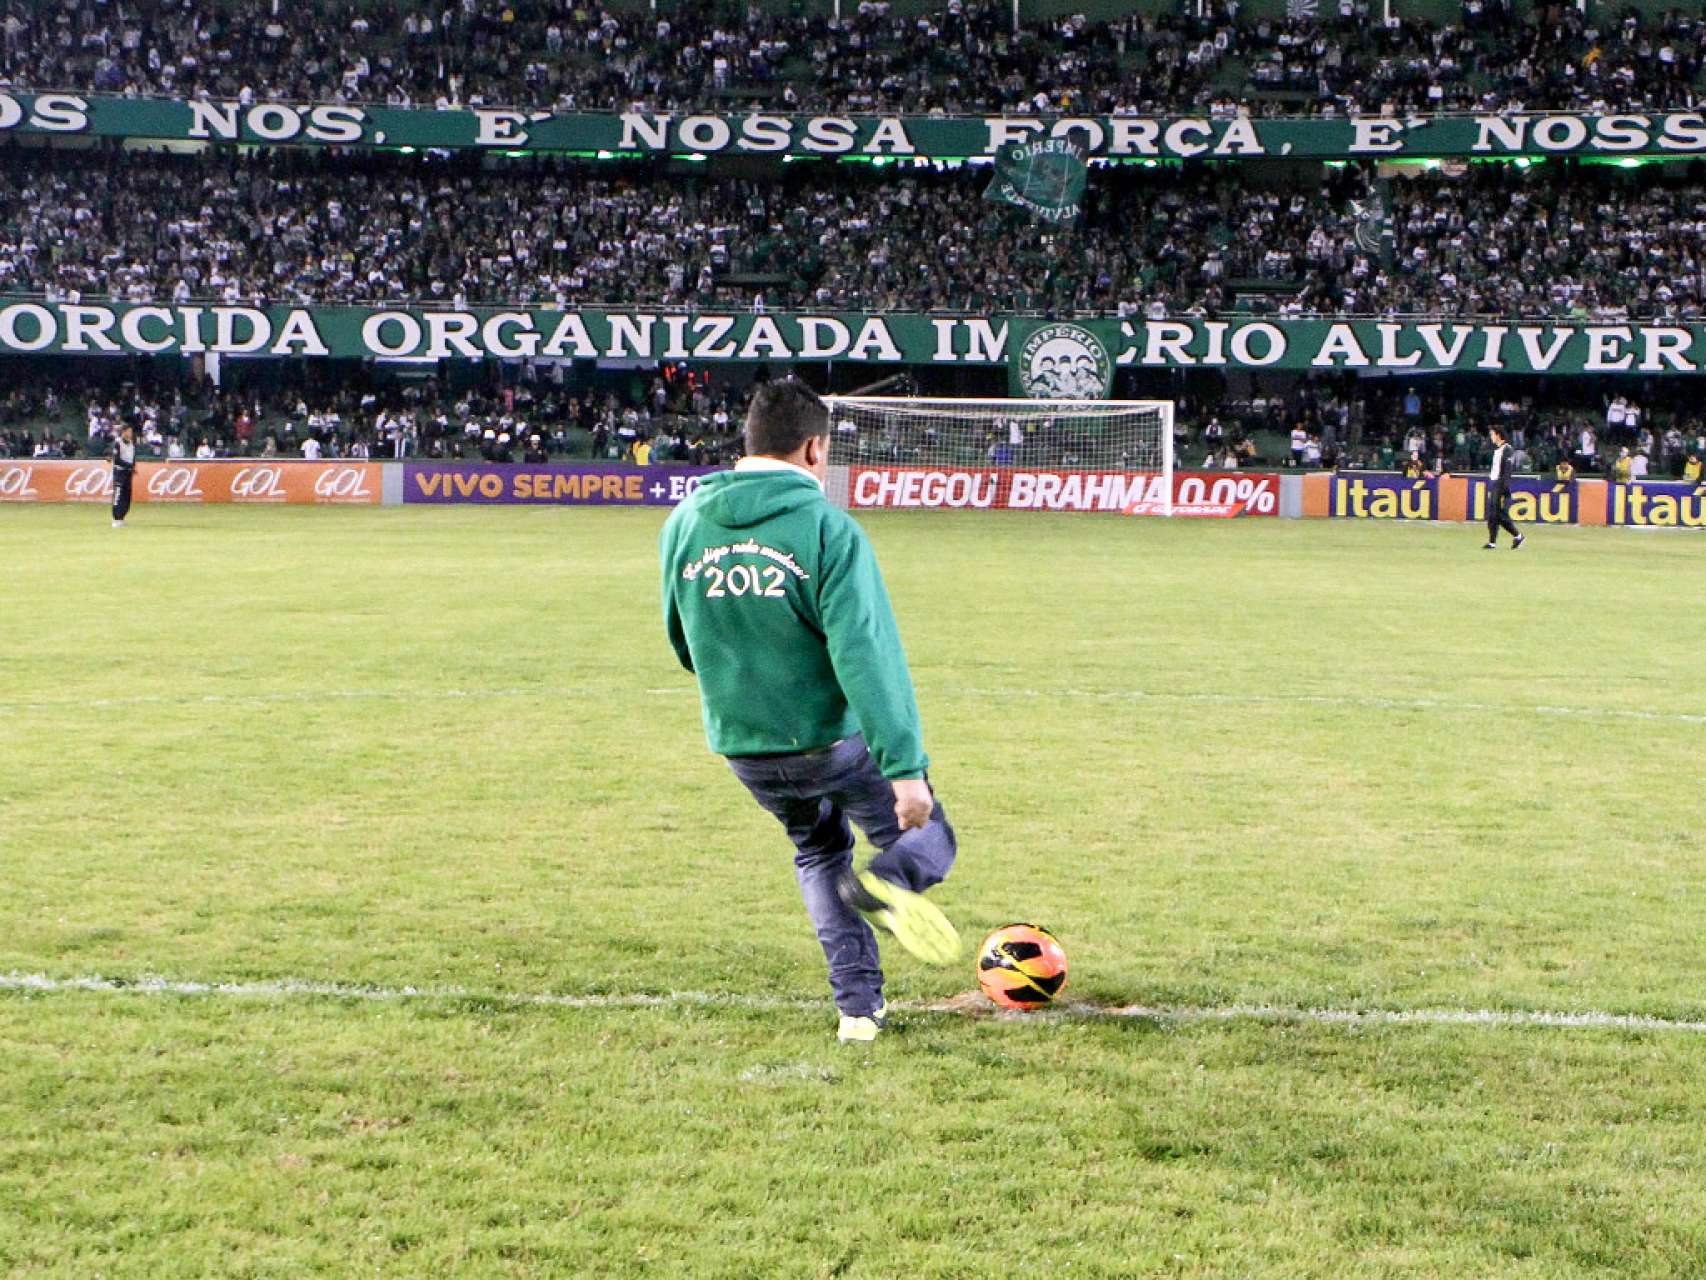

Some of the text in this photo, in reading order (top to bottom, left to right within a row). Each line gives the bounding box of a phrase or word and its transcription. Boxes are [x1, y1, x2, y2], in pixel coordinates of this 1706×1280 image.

[618, 113, 914, 153] NOSSA
[0, 304, 1706, 372] ORCIDA ORGANIZADA IMRIO ALVIVER
[0, 467, 38, 496] OL
[148, 467, 204, 496] GOL
[230, 467, 289, 497] GOL
[314, 467, 371, 497] GOL
[415, 472, 504, 497] VIVO
[513, 474, 645, 500] SEMPRE
[854, 470, 998, 508] CHEGOU
[1008, 473, 1171, 510] BRAHMA
[1336, 478, 1430, 519] Itaú
[1474, 480, 1570, 523] Iaú
[1614, 484, 1706, 527] Itaú
[704, 564, 786, 598] 2012
